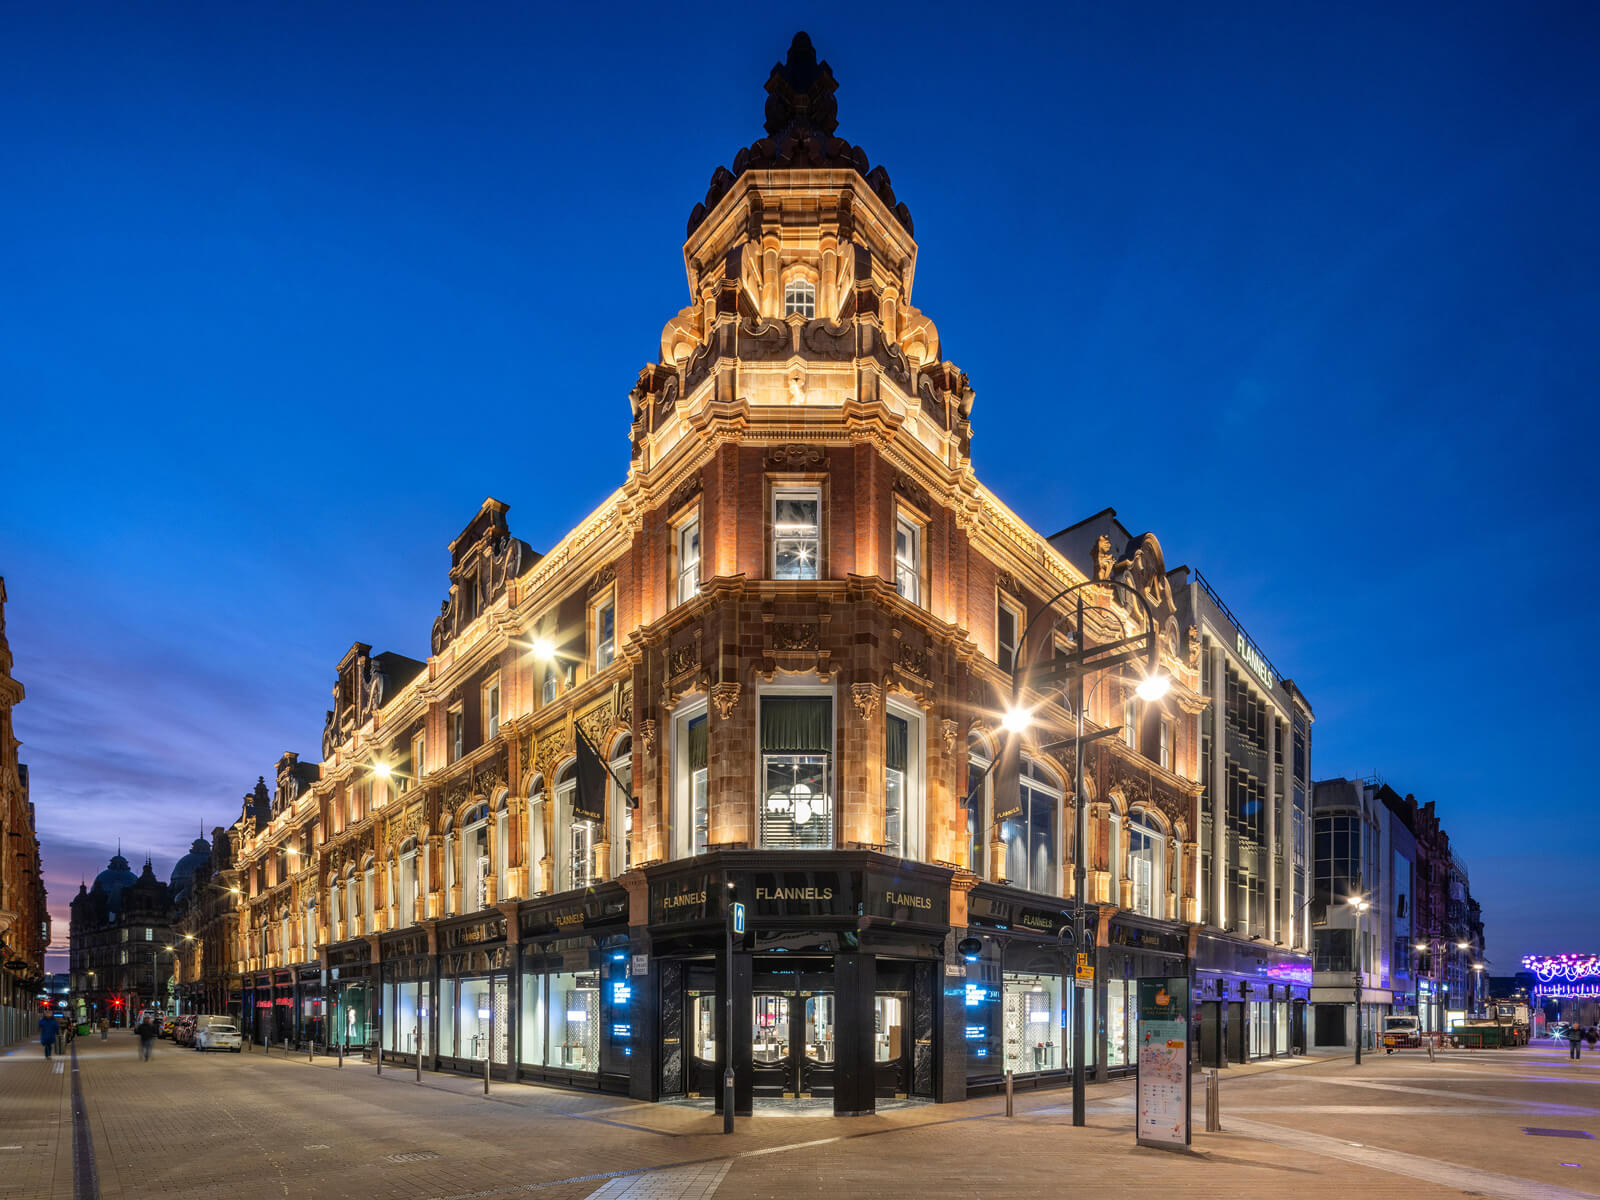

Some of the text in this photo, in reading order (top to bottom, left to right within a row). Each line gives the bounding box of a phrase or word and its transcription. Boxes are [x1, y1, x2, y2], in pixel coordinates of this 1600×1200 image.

[1237, 633, 1272, 690] FLANNELS
[664, 890, 707, 909] FLANNELS
[756, 887, 832, 900] FLANNELS
[886, 891, 931, 909] FLANNELS
[556, 912, 584, 927] FLANNELS
[1023, 914, 1053, 928] FLANNELS
